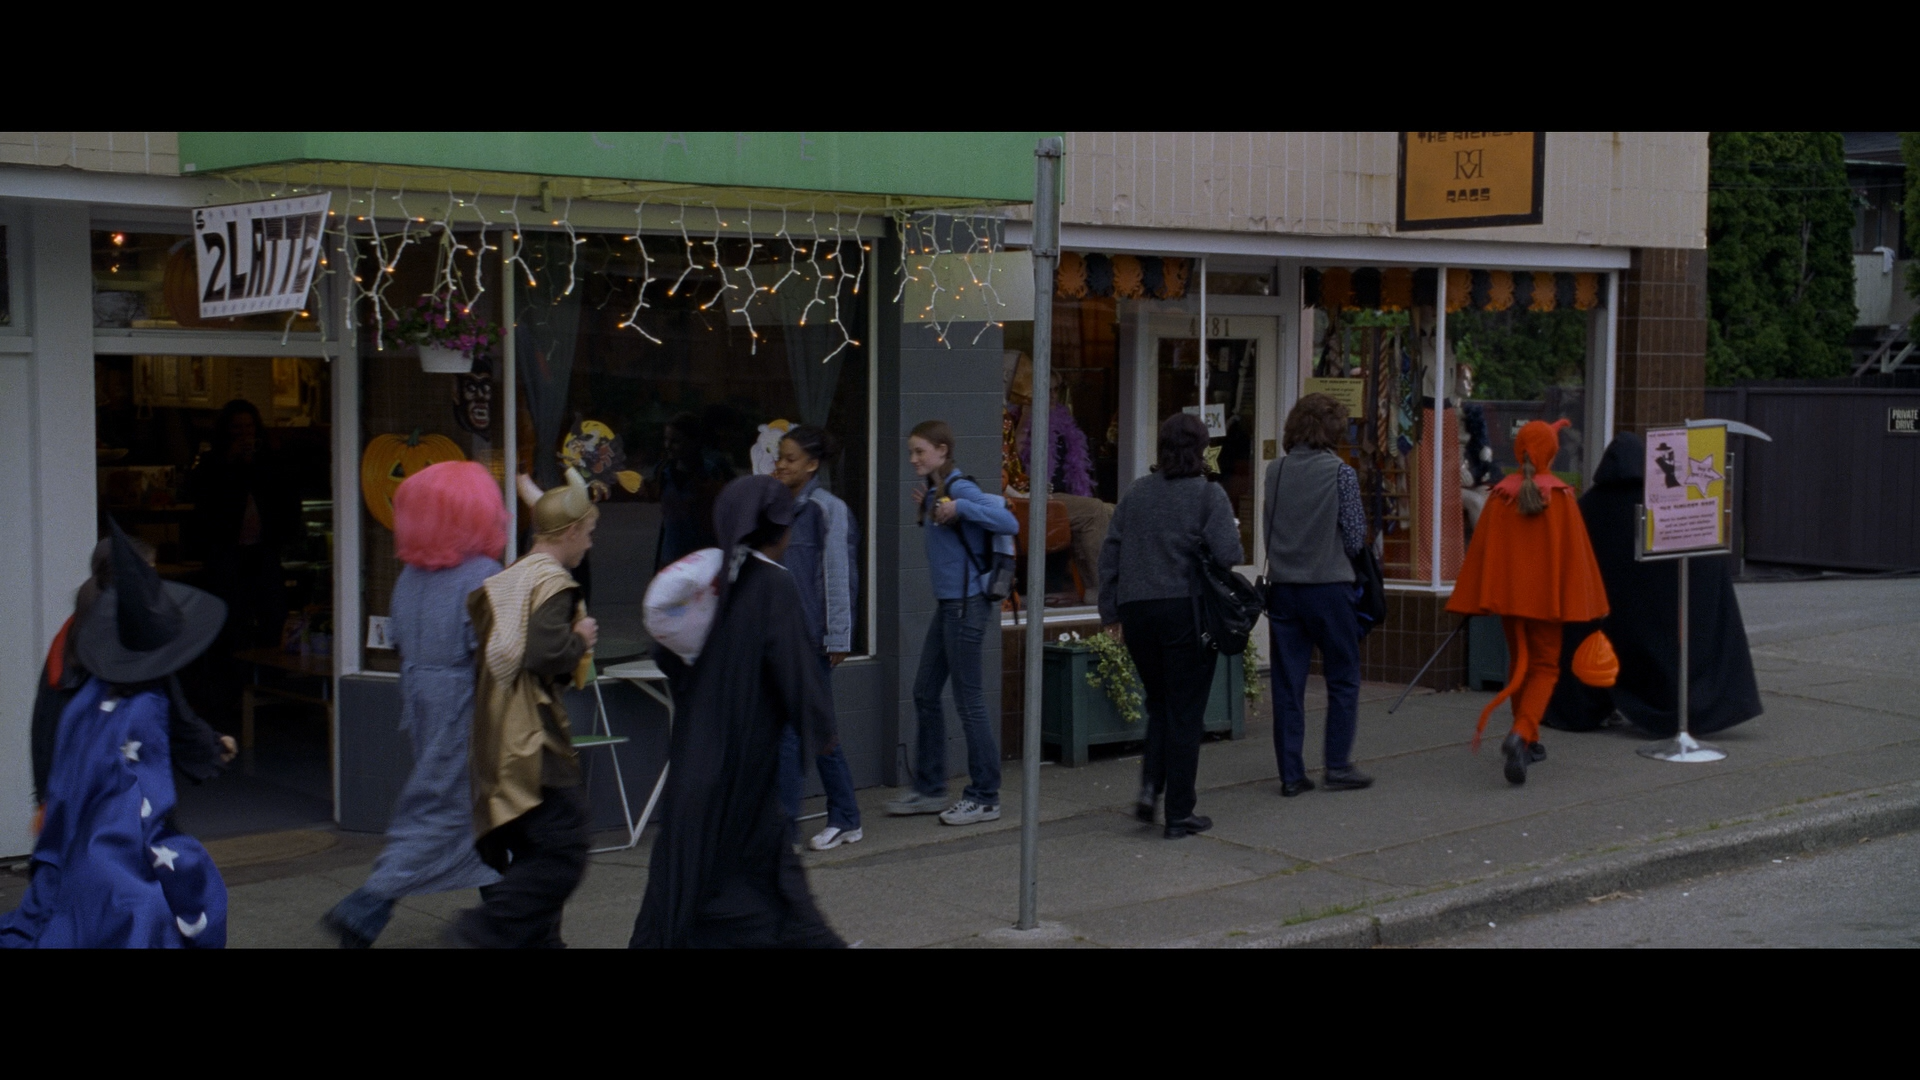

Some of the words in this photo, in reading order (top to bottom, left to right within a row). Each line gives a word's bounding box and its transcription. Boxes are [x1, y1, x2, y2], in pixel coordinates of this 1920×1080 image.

[1417, 132, 1447, 143] THE
[1446, 187, 1491, 202] RAGS
[1190, 317, 1230, 337] 481
[1892, 409, 1919, 420] PRIVATE
[1895, 420, 1915, 430] DRIVE
